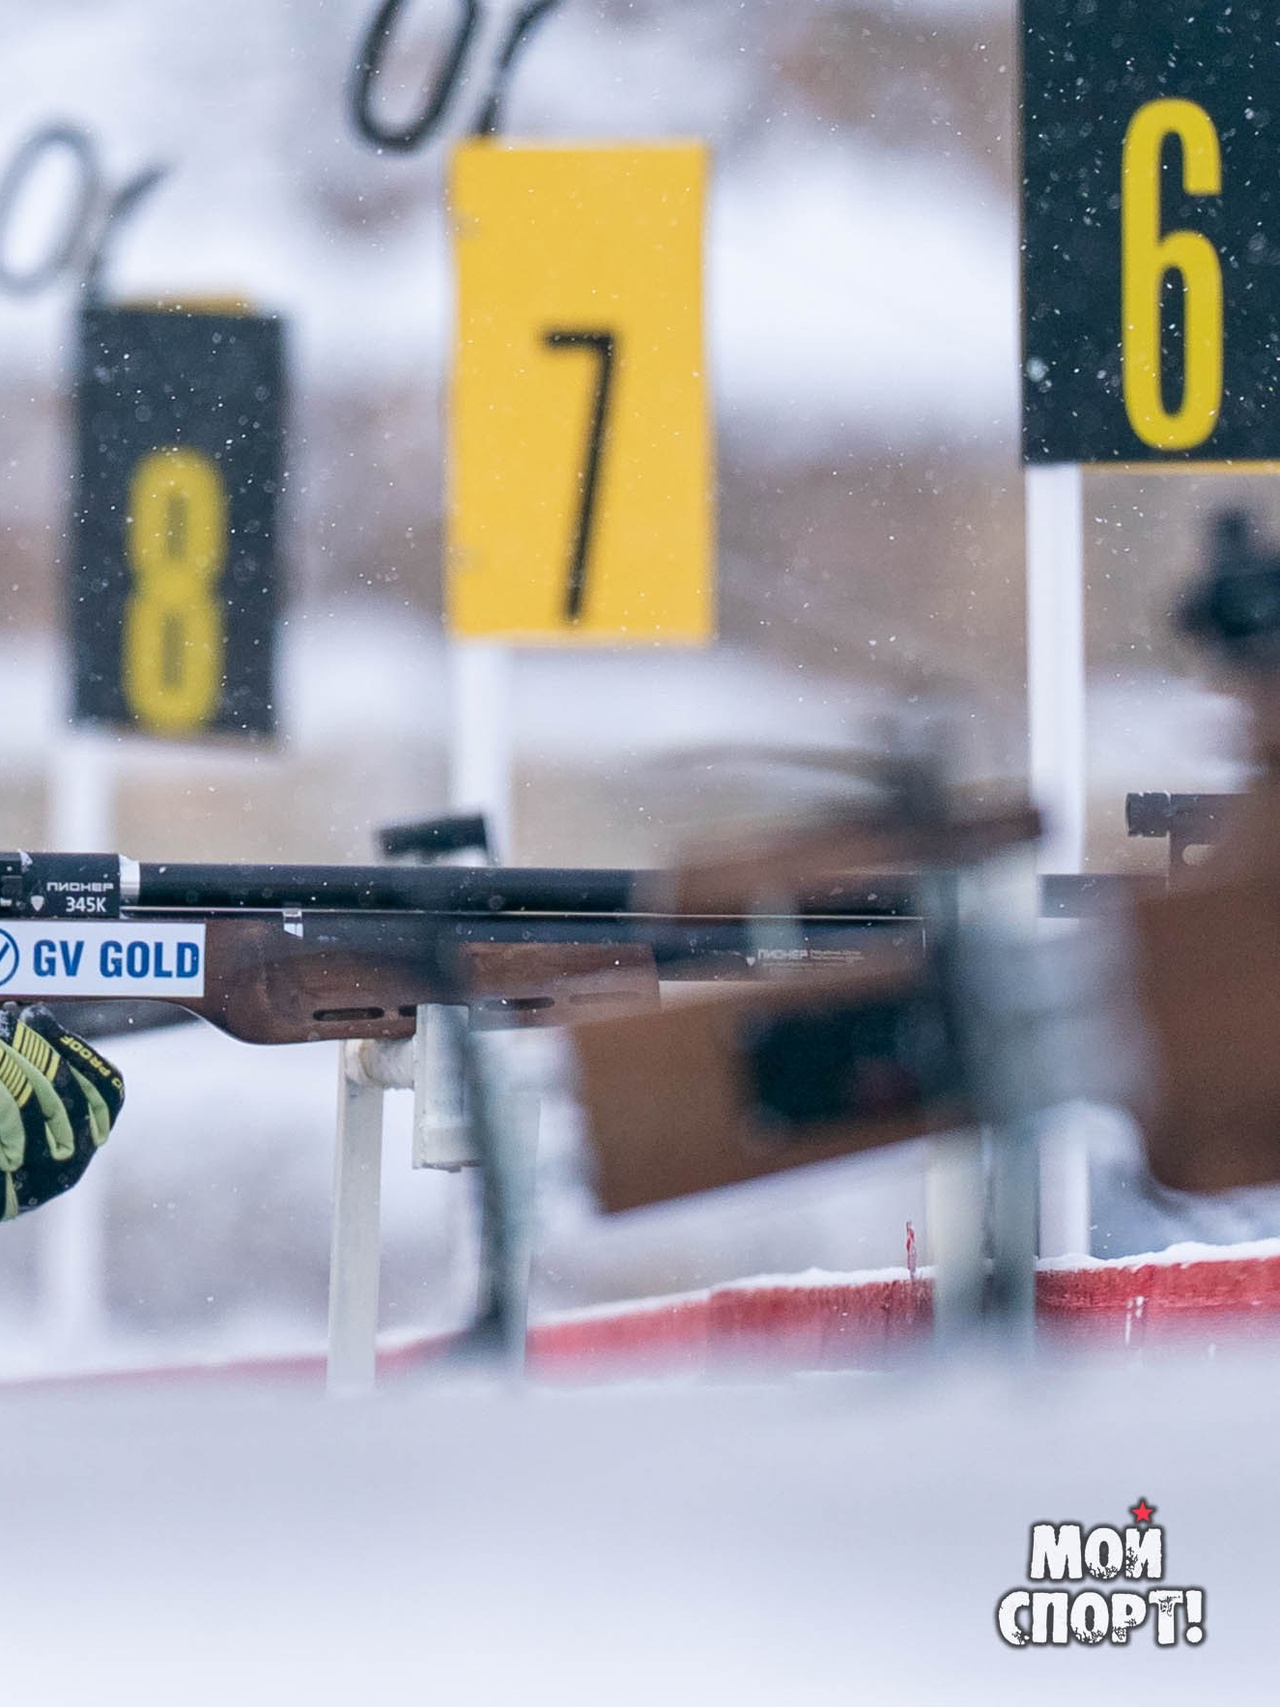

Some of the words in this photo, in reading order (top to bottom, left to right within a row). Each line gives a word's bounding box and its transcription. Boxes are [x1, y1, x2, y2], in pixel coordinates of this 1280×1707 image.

[1122, 97, 1224, 451] 6
[126, 446, 227, 736] 8
[540, 329, 619, 622] 7
[33, 940, 85, 978] GV
[99, 940, 200, 979] GOLD
[46, 881, 115, 893] ПИОНЕР
